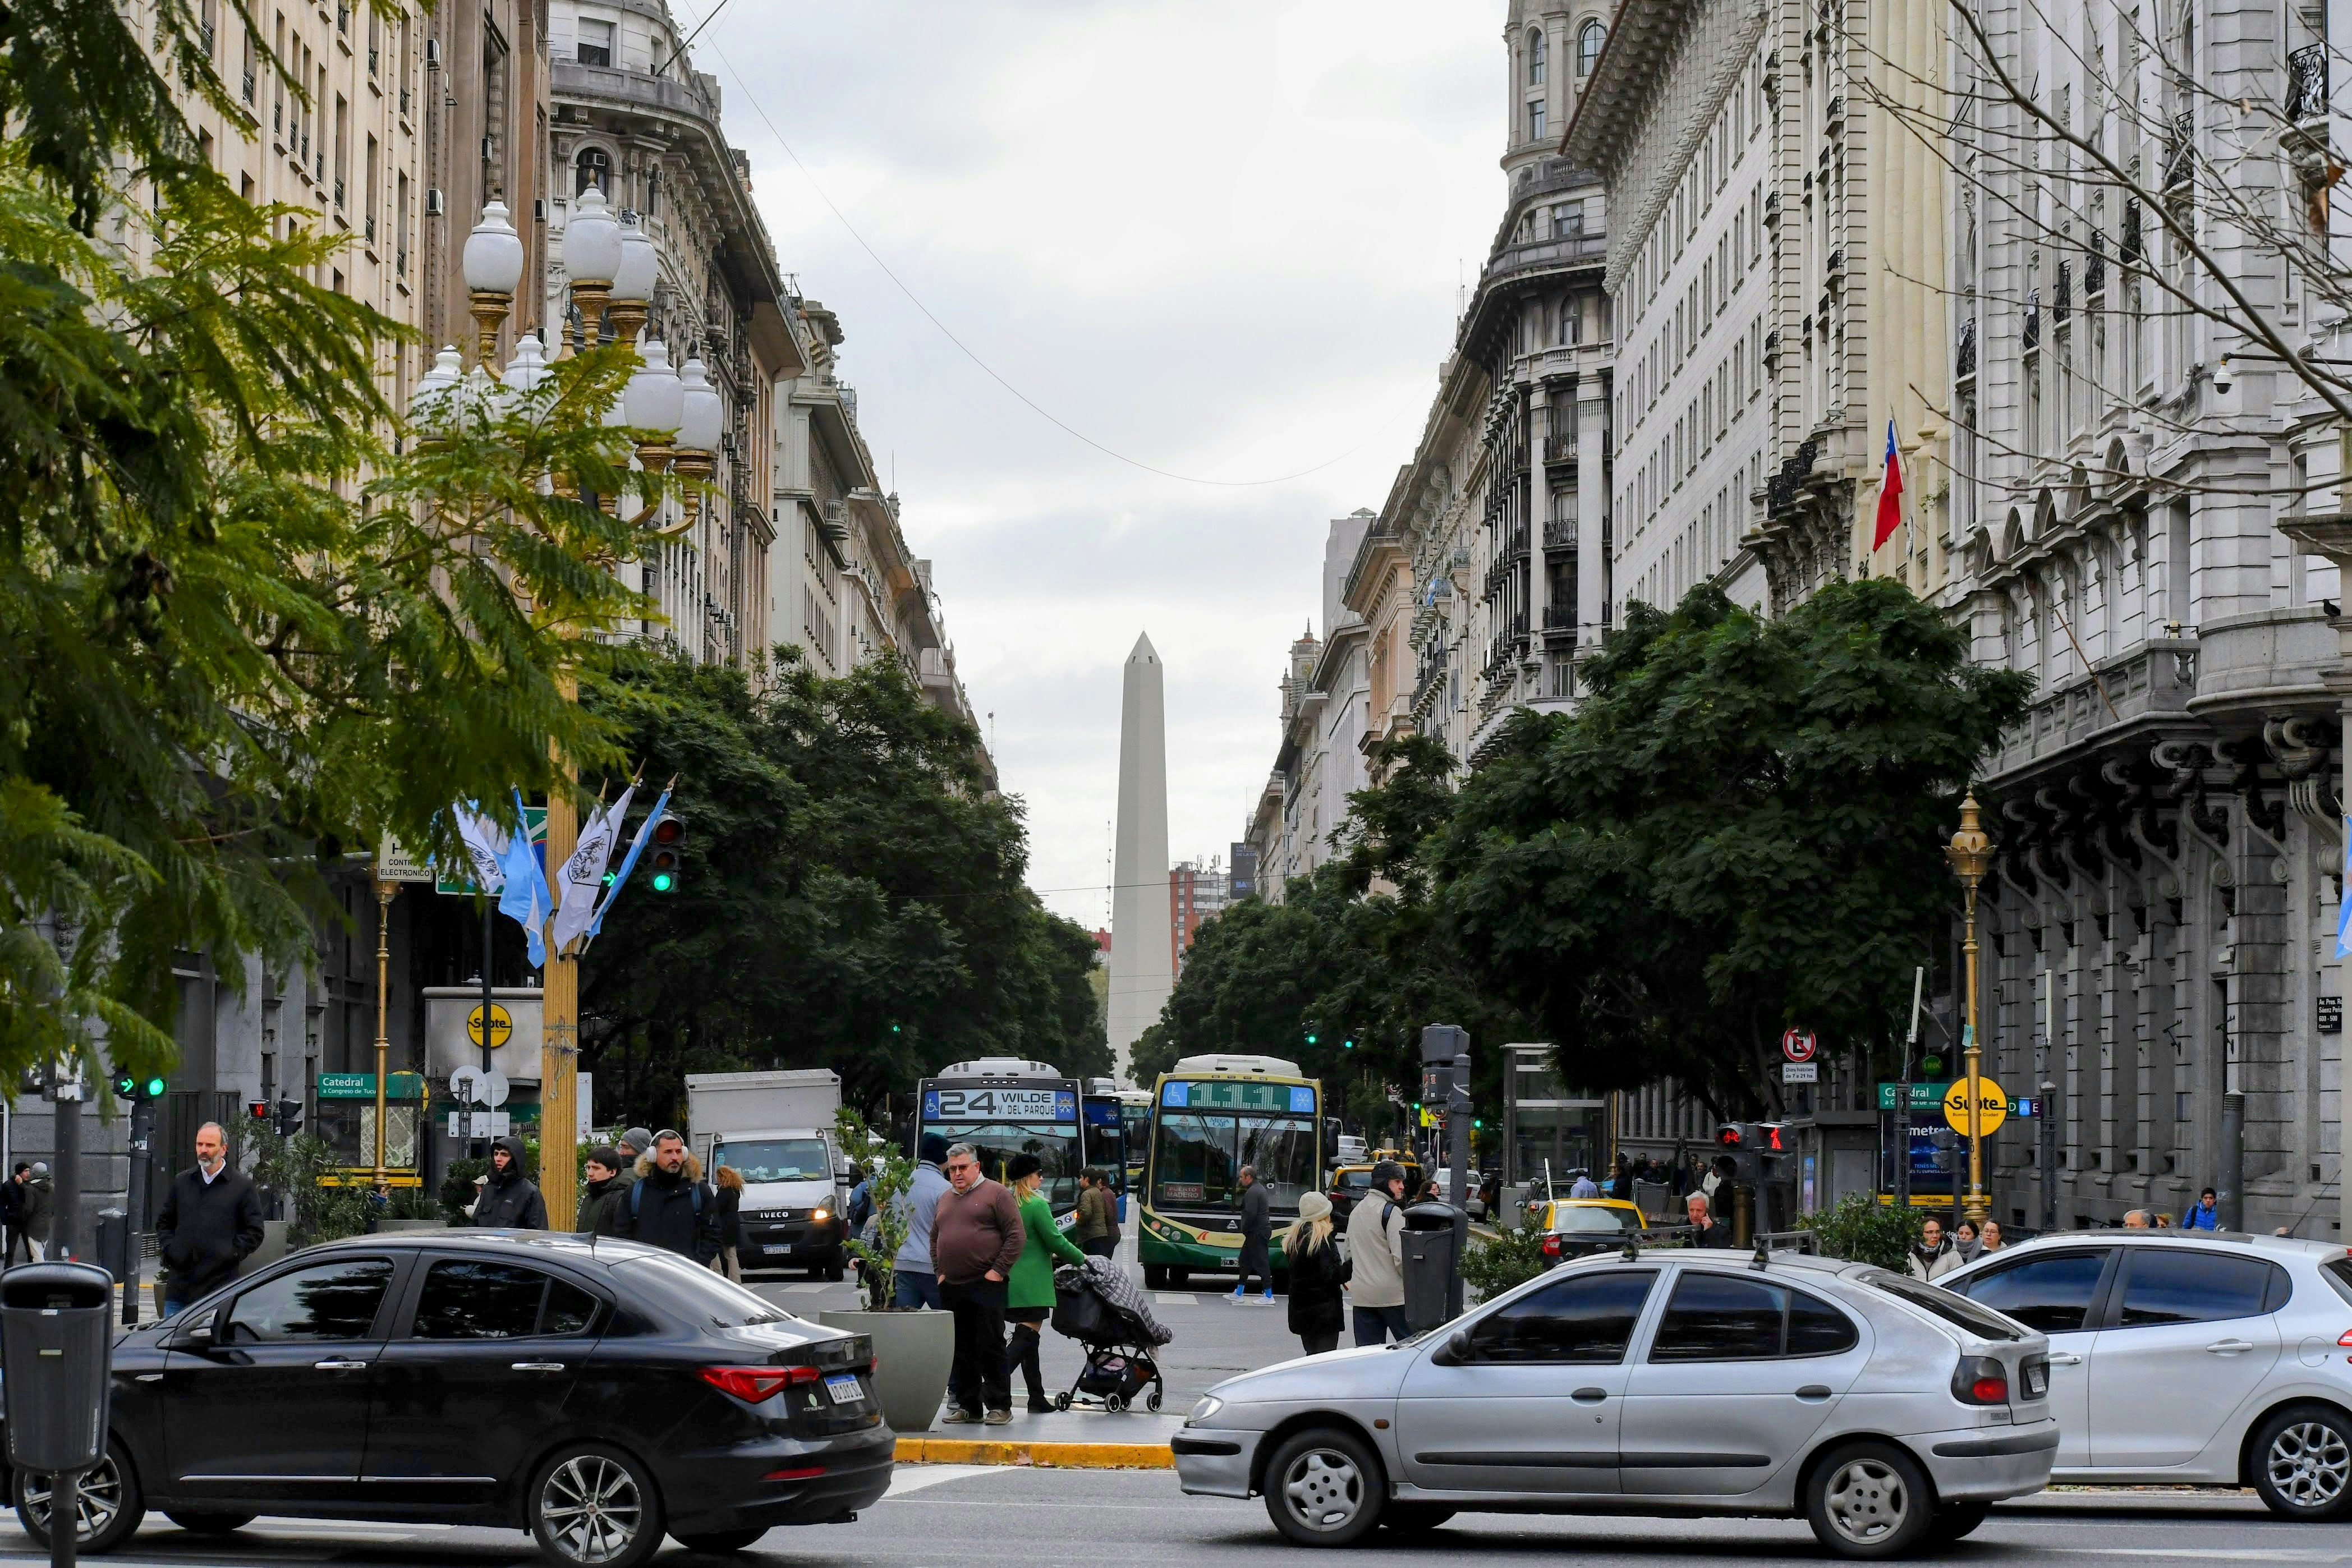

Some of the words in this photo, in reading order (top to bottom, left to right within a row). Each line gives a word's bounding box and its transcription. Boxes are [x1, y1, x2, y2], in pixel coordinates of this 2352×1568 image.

[473, 1018, 507, 1028] Ste
[323, 1077, 364, 1087] Catedral
[1191, 1083, 1281, 1111] 111
[1885, 1087, 1929, 1097] Cadral
[1002, 1093, 1051, 1103] WILDE
[940, 1092, 996, 1115] 24
[2008, 1102, 2016, 1112] D
[2020, 1102, 2029, 1110] A
[2032, 1103, 2039, 1113] E
[998, 1105, 1005, 1115] V.
[1008, 1105, 1022, 1115] DEL
[1024, 1105, 1055, 1116] PARQUE
